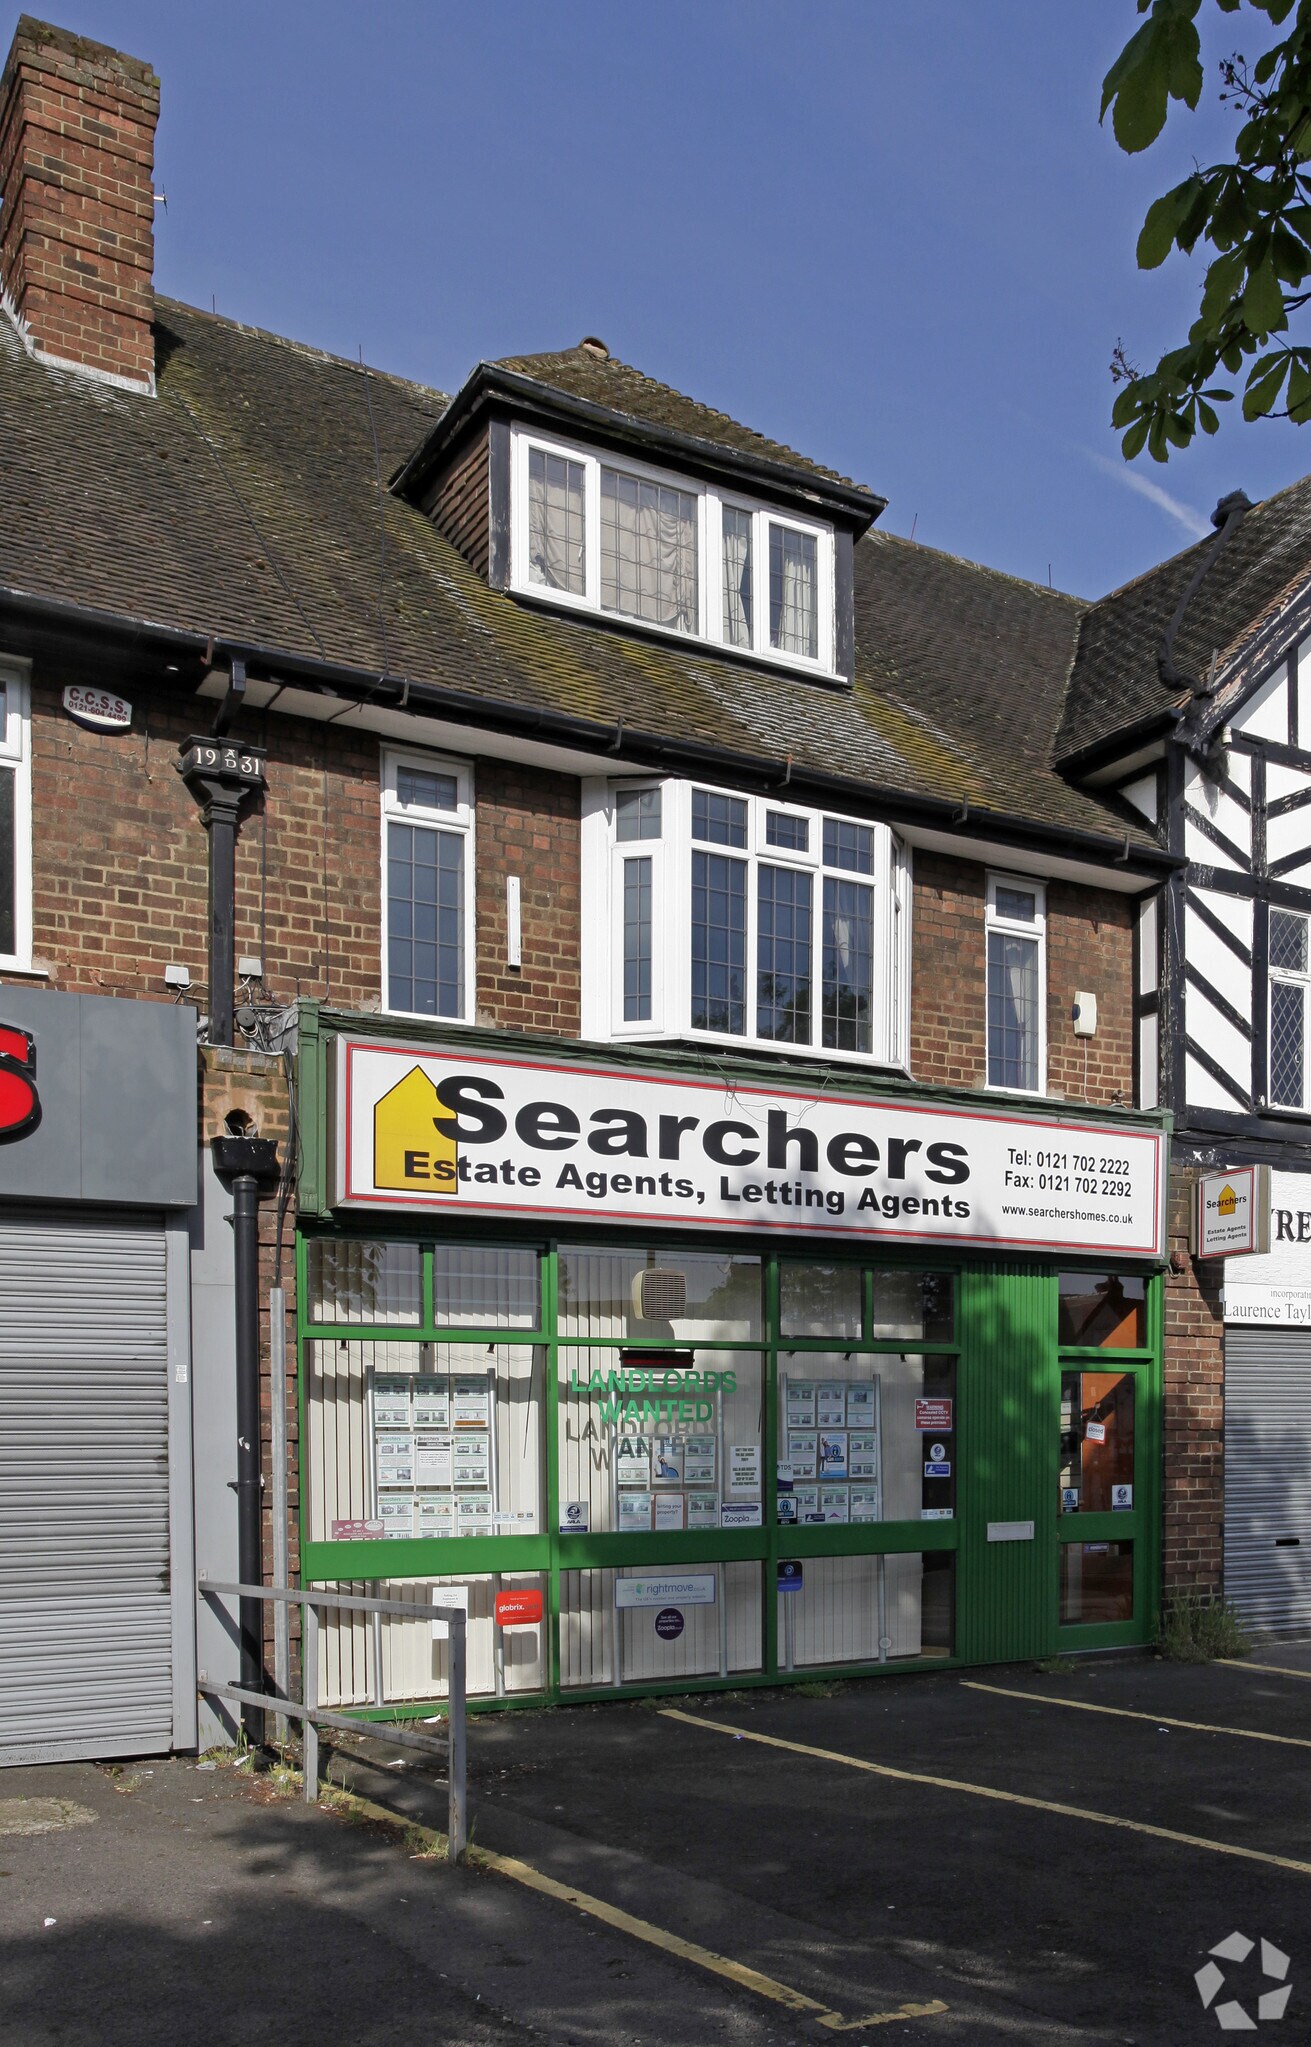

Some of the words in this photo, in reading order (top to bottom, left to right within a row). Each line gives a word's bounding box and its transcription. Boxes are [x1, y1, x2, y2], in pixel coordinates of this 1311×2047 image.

[68, 701, 106, 718] 0121-604
[106, 711, 127, 723] 4499
[69, 687, 128, 715] C.C.S.S.
[195, 748, 216, 766] 19
[241, 756, 259, 775] 31
[432, 1075, 971, 1185] Searchers
[1007, 1148, 1032, 1166] Tel:
[1037, 1151, 1067, 1169] 0121
[1072, 1155, 1096, 1172] 702
[1099, 1158, 1130, 1175] 2222
[404, 1150, 541, 1187] Estate
[555, 1163, 706, 1205] Agents,
[720, 1176, 845, 1215] Letting
[857, 1187, 971, 1219] Agents
[1005, 1170, 1034, 1188] Fax:
[1039, 1174, 1069, 1192] 0121
[1075, 1177, 1098, 1194] 702
[1101, 1180, 1132, 1197] 2292
[1206, 1195, 1247, 1209] Searchers
[1001, 1205, 1133, 1224] www.searchershomes.co.uk
[1206, 1235, 1227, 1243] Letting
[1227, 1232, 1247, 1240] Agents
[1227, 1225, 1246, 1233] Agents
[1224, 1300, 1281, 1318] Laurence
[571, 1369, 737, 1393] LANDLORDS
[597, 1399, 713, 1423] WANTED
